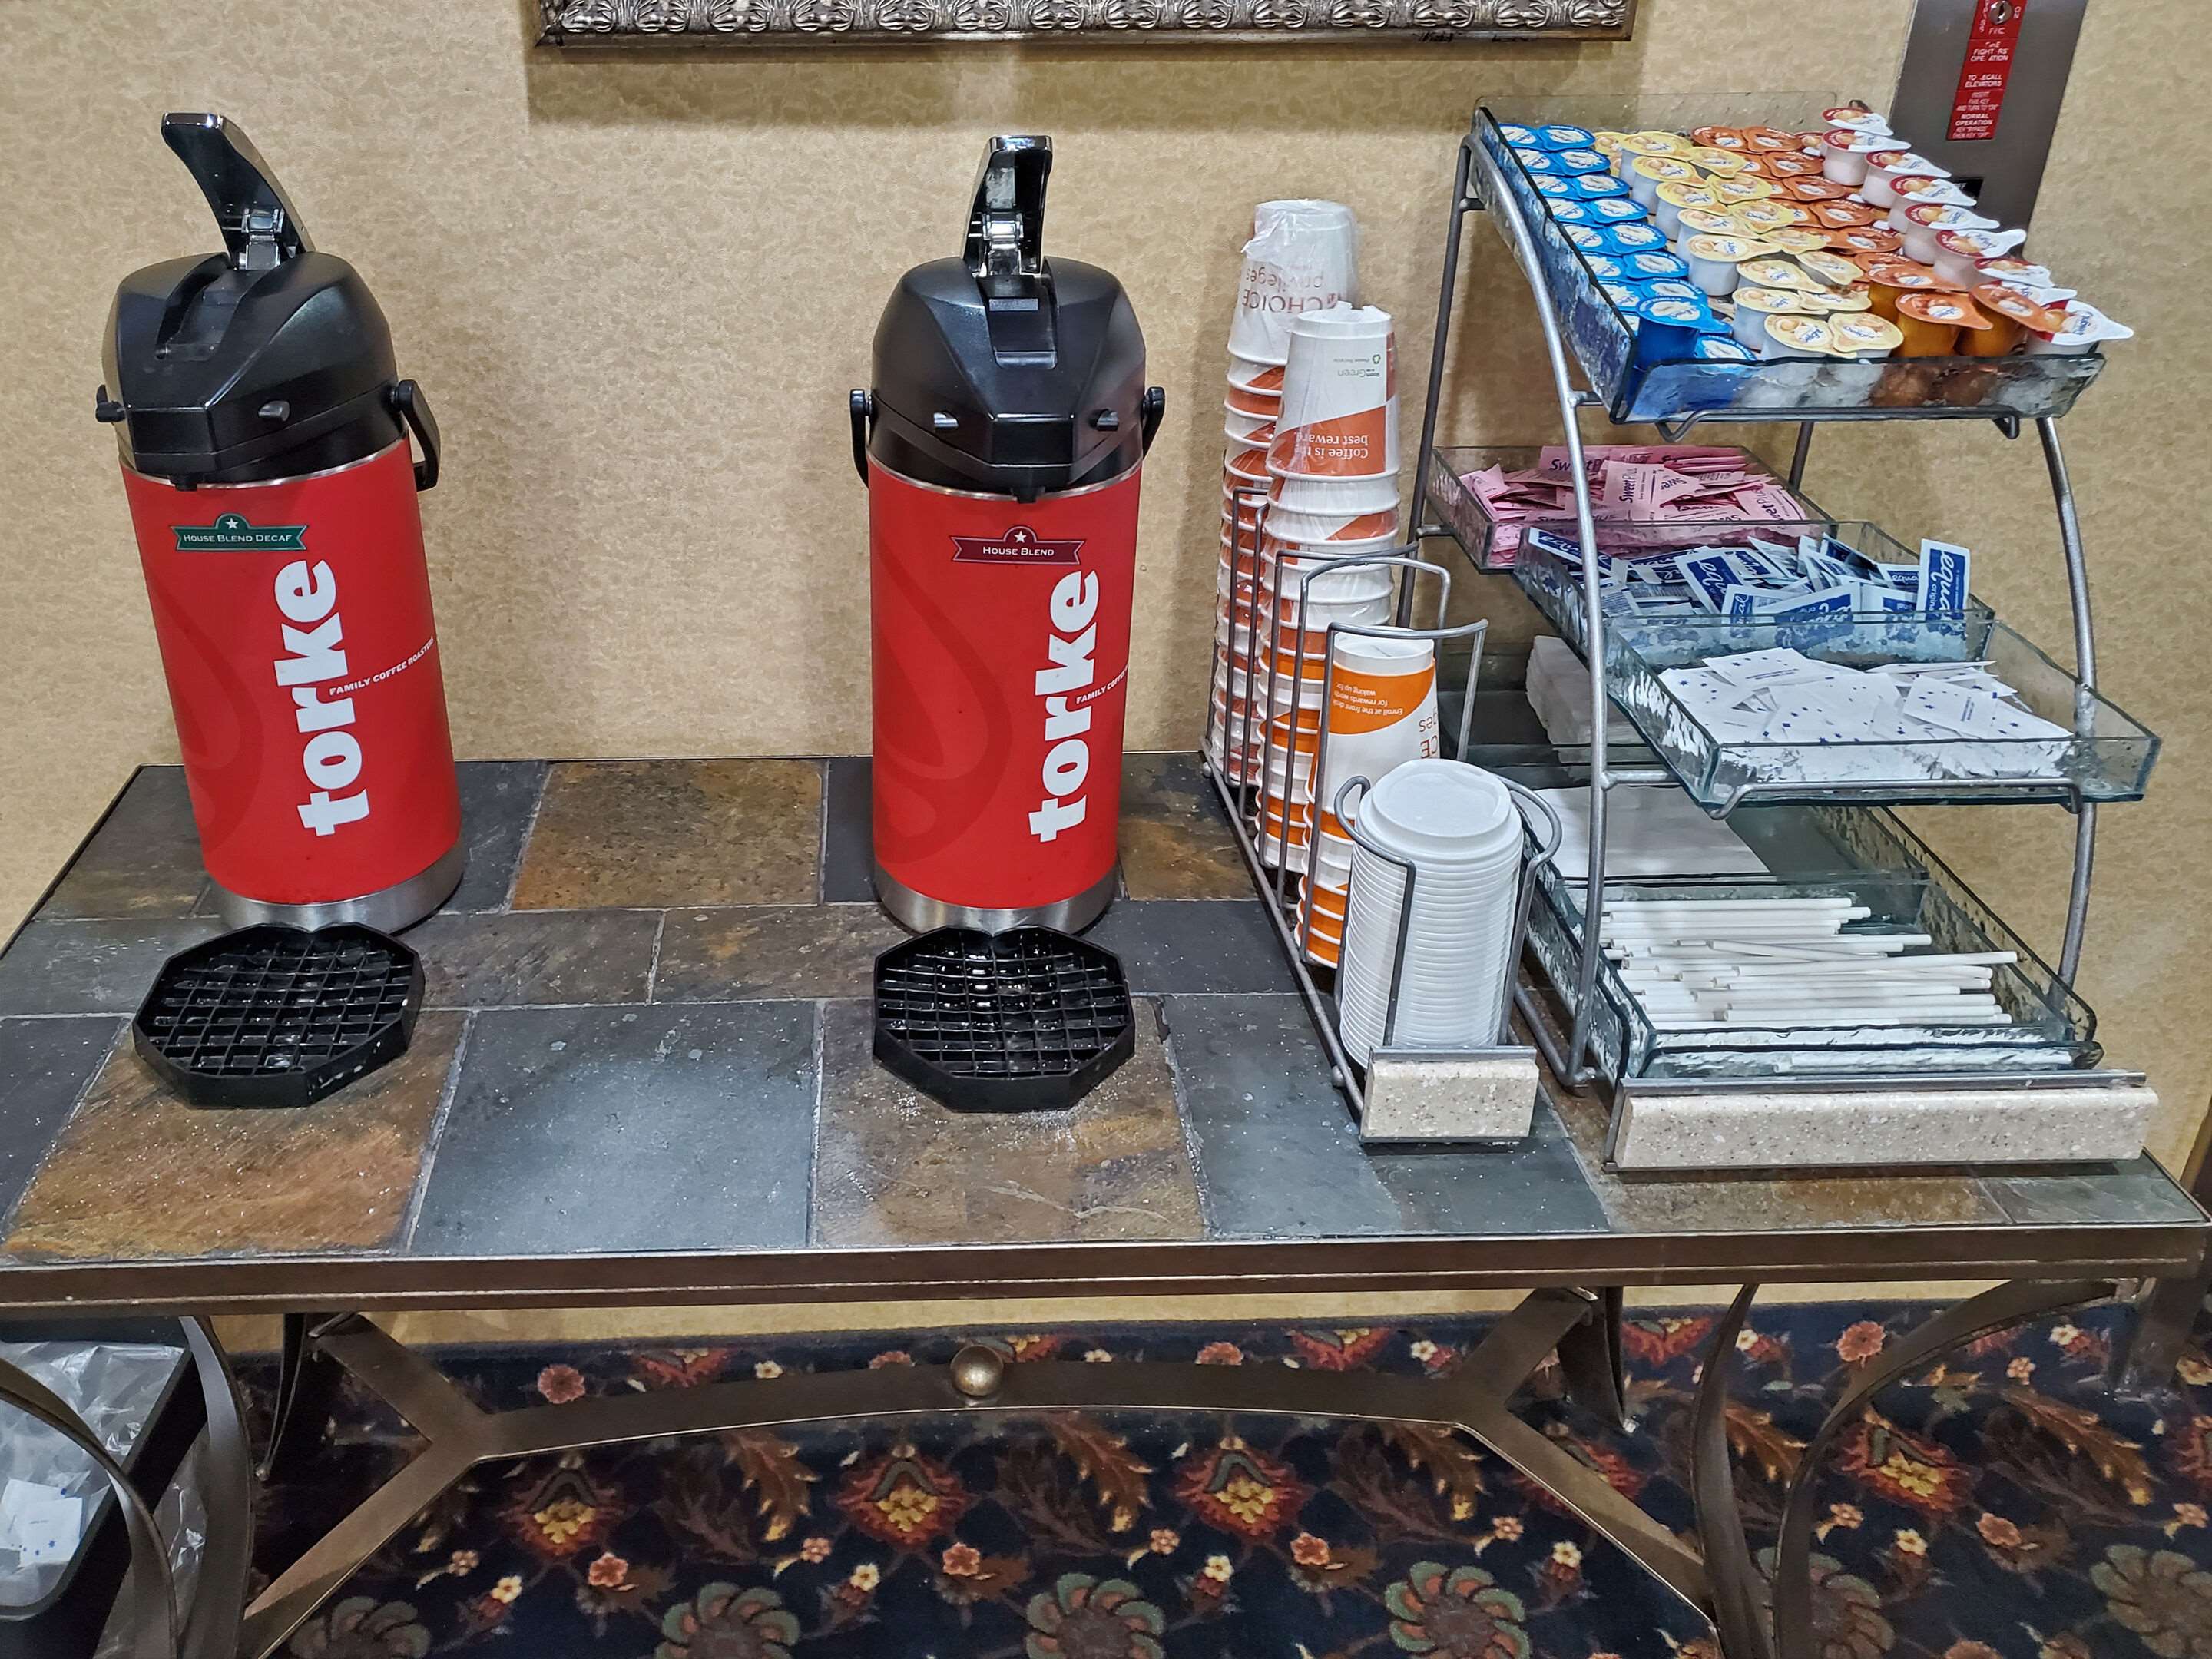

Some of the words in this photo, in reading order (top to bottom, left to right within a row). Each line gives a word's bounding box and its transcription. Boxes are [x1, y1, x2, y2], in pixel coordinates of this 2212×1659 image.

[1242, 289, 1323, 313] CHOICE
[1342, 435, 1369, 445] best
[1315, 447, 1326, 459] is
[1329, 448, 1369, 459] Coffee
[329, 677, 370, 696] FAMILY
[373, 661, 407, 683] COFFEE
[273, 559, 369, 836] torke
[1076, 685, 1106, 704] FAMILY
[1028, 570, 1099, 843] torke
